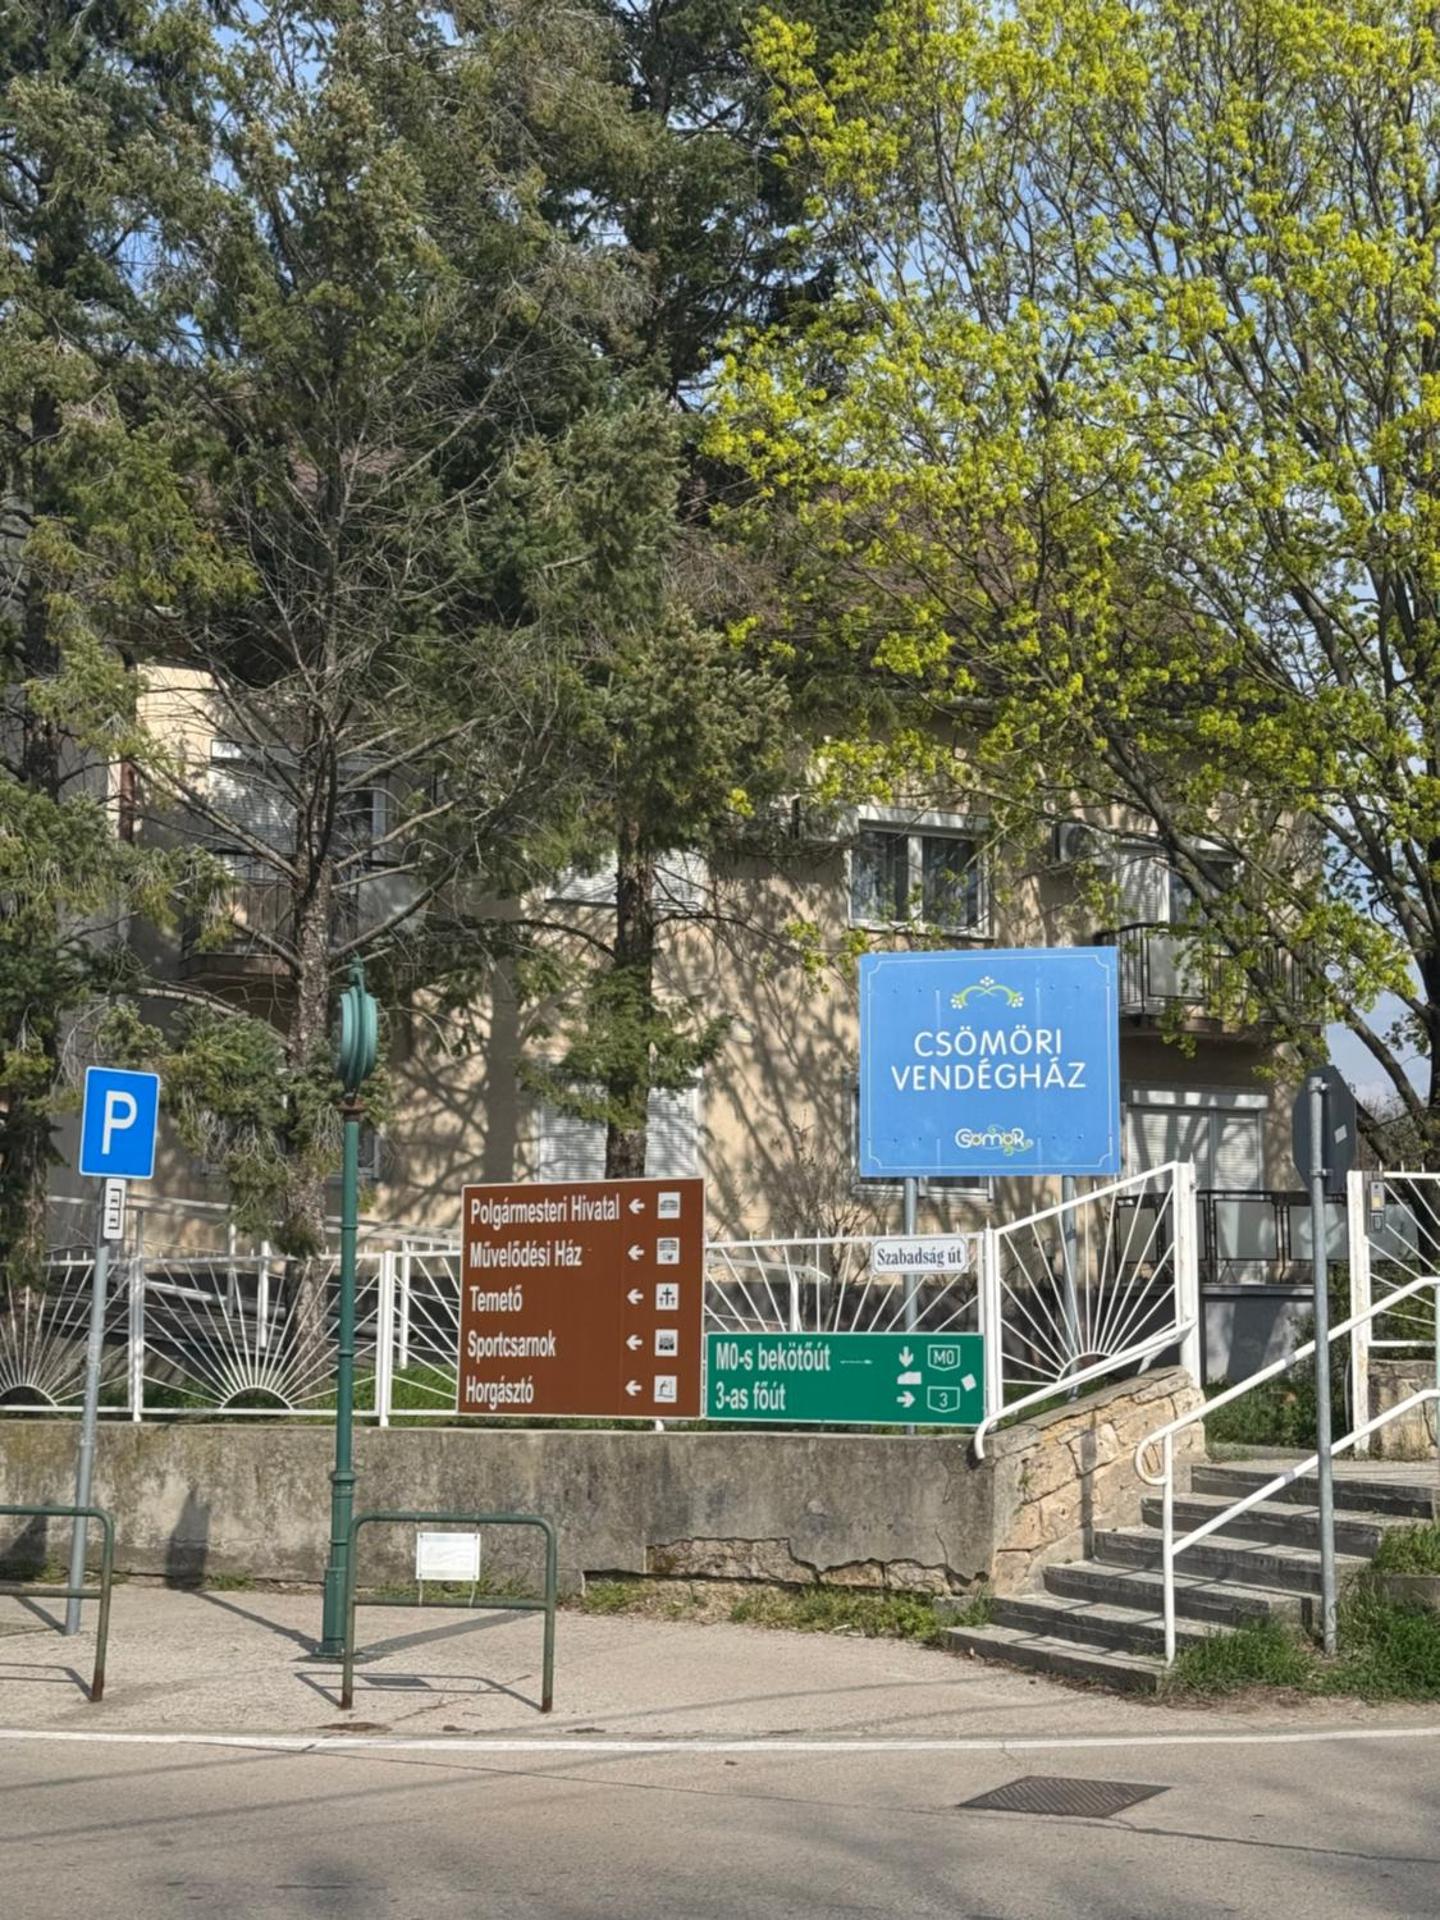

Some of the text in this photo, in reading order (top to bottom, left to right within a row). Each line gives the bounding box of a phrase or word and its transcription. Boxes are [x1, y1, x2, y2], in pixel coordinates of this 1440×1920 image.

[914, 1024, 1062, 1057] CSÖMÖRI
[891, 1057, 1086, 1091] VENDÉGHÁZ
[101, 1090, 138, 1155] P
[470, 1193, 620, 1231] Polgármesteri Hivatal
[470, 1239, 583, 1268] Művelődési Ház
[877, 1246, 962, 1268] Szabadság út
[469, 1285, 523, 1312] Temető
[467, 1330, 556, 1363] Sportcsarnok
[716, 1341, 831, 1371] M0-s bekötőút
[933, 1349, 955, 1365] M0
[466, 1375, 534, 1410] Horgásztó
[716, 1381, 786, 1411] 3-as főút
[939, 1392, 948, 1408] 3
